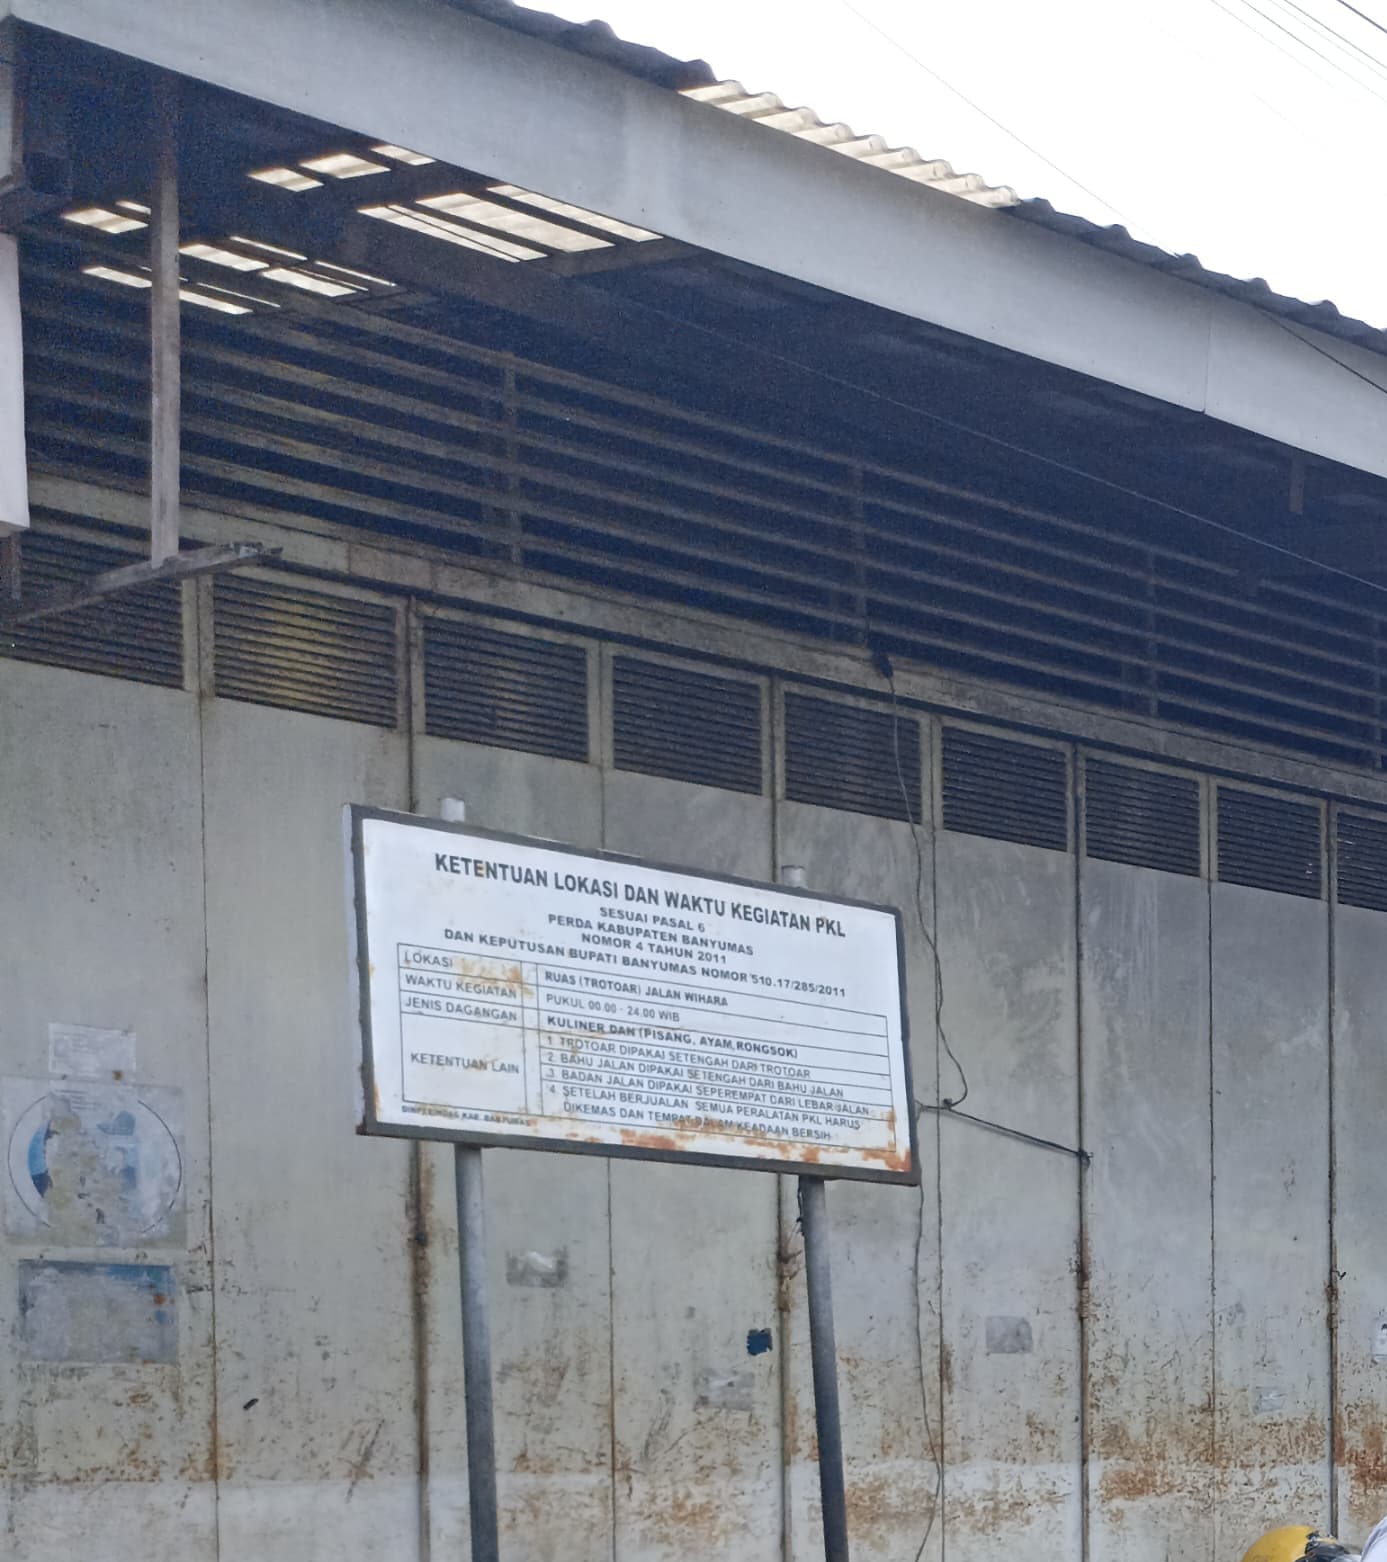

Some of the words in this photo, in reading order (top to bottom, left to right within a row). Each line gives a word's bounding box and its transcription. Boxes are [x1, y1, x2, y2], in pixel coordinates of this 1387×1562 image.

[435, 853, 548, 888] KETENTUAN
[554, 872, 619, 899] LOKASI
[624, 884, 659, 906] DAN
[665, 891, 725, 916] WAKTU
[731, 902, 810, 932] KEGIATAN
[816, 919, 846, 937] PKL
[548, 914, 593, 930] PERDA
[598, 918, 678, 943] KABUPATEN
[682, 934, 754, 956] BANYUMAS
[600, 906, 648, 923] SESUAI
[653, 915, 694, 931] PASAL
[698, 922, 705, 933] 6
[404, 950, 453, 968] LOKASI
[444, 928, 474, 943] DAN
[479, 934, 565, 957] KEPUTUSAN
[569, 947, 617, 964] BUPATI
[622, 956, 697, 976] BANYUMAS
[701, 967, 748, 983] NOMOR
[582, 933, 631, 949] NOMOR
[635, 940, 643, 951] 4
[649, 942, 693, 959] TAHUN
[697, 951, 727, 964] 2011
[405, 974, 451, 991] WAKTU
[456, 981, 517, 999] KEGIATAN
[545, 971, 576, 987] RUAS
[579, 975, 641, 995] (TROTOAR)
[645, 987, 681, 1001] JALAN
[685, 992, 728, 1007] WIHARA
[405, 996, 442, 1011] JENIS
[446, 1002, 517, 1021] DAGANGAN
[546, 993, 584, 1010] PUKUL
[627, 1005, 655, 1018] 24.00
[659, 1010, 680, 1023] WIB
[547, 1016, 605, 1033] KULINER
[609, 1024, 636, 1037] DAN
[411, 1052, 488, 1070] KETENTUAN
[491, 1060, 520, 1074] LAIN
[560, 1037, 616, 1054] TROTOAR
[619, 1045, 665, 1059] DIPAKAI
[669, 1051, 729, 1068] SETENGAH
[731, 1060, 757, 1072] DARI
[760, 1063, 811, 1079] TROTOAR
[561, 1054, 594, 1067] BAHU
[597, 1058, 636, 1072] JALAN
[638, 1063, 684, 1078] DIPAKAI
[687, 1069, 746, 1086] SETENGAH
[749, 1077, 774, 1089] DARI
[777, 1081, 807, 1093] BAHU
[810, 1085, 844, 1098] JALAN
[562, 1070, 602, 1084] BADAN
[606, 1075, 644, 1088] JALAN
[648, 1080, 693, 1095] DIPAKAI
[696, 1086, 767, 1106] SEPEREMPAT
[769, 1095, 796, 1107] DARI
[798, 1099, 834, 1111] LEBAR
[836, 1103, 870, 1115] JALAN
[562, 1086, 616, 1102] SETELAH
[619, 1092, 688, 1109] BERJUALAN
[695, 1101, 734, 1115] SEMUA
[736, 1105, 799, 1123] PERALATAN
[802, 1113, 822, 1125] PKL
[825, 1117, 861, 1130] HARUS
[563, 1102, 616, 1119] DIKEMAS
[619, 1106, 644, 1120] DAN
[792, 1128, 831, 1142] BERSIH
